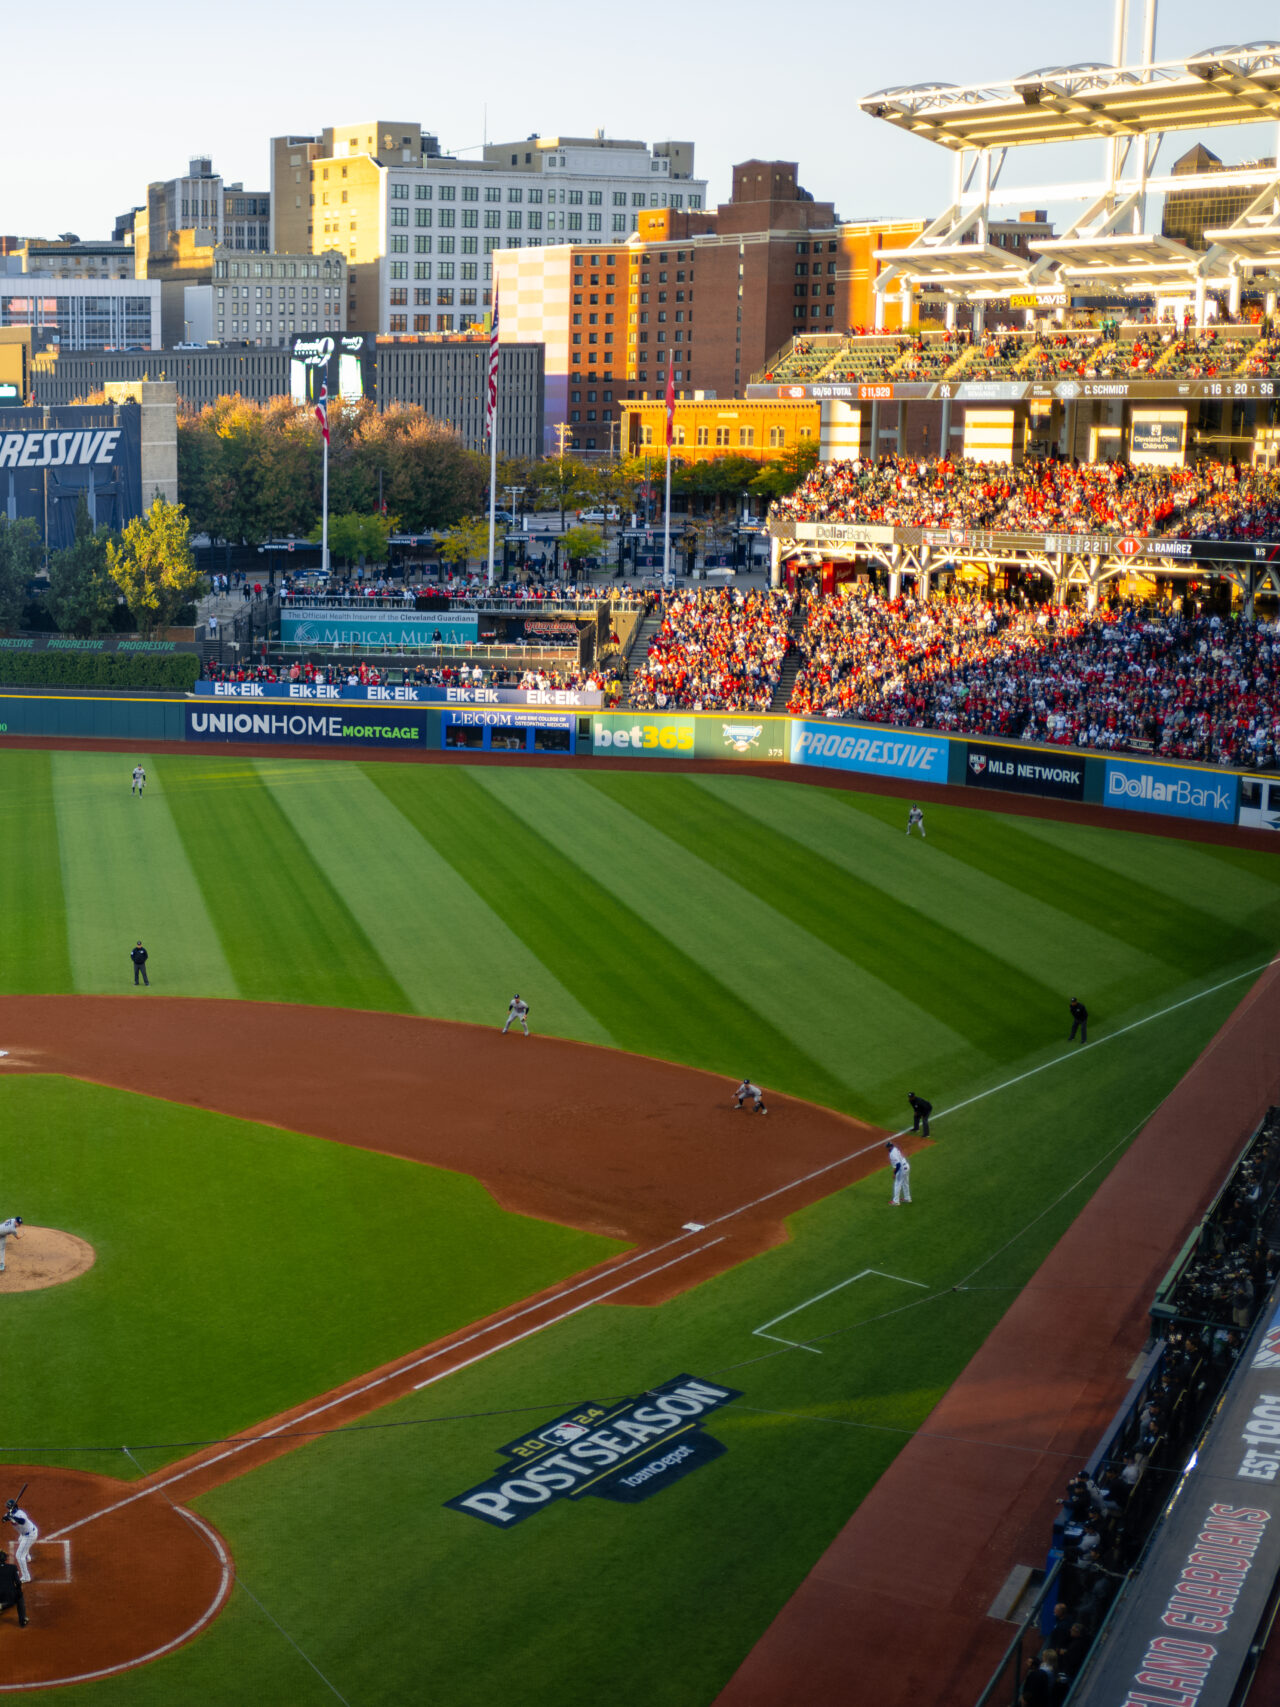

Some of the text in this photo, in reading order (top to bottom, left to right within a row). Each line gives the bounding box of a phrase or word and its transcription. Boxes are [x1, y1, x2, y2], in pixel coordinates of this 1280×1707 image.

[812, 384, 830, 396] 50/50
[831, 384, 852, 396] TOTAL
[1092, 385, 1130, 395] SCHMIDT
[1211, 384, 1222, 394] 16
[1235, 384, 1248, 394] 20
[1260, 384, 1274, 394] 36
[816, 526, 870, 540] DollarBank
[1124, 542, 1134, 552] 11
[1155, 542, 1192, 554] RAMÍREZ
[400, 614, 436, 622] Cleveland
[437, 614, 475, 622] Guardians
[524, 618, 579, 634] Guardians
[324, 628, 393, 644] MEDICAL
[47, 640, 104, 650] PROGRESSIVE
[117, 641, 176, 650] PROGRESSIVE
[594, 724, 694, 750] bet365
[768, 748, 783, 757] 375
[794, 732, 938, 770] PROGRESSIVE
[988, 760, 1080, 784] MLB NETWORK
[1109, 771, 1229, 810] DollarBank
[573, 1408, 604, 1424] 24
[461, 1382, 729, 1522] POSTSEASON
[512, 1440, 546, 1457] 20
[620, 1445, 694, 1488] loanDepot
[1161, 1503, 1272, 1634] GUARDIANS
